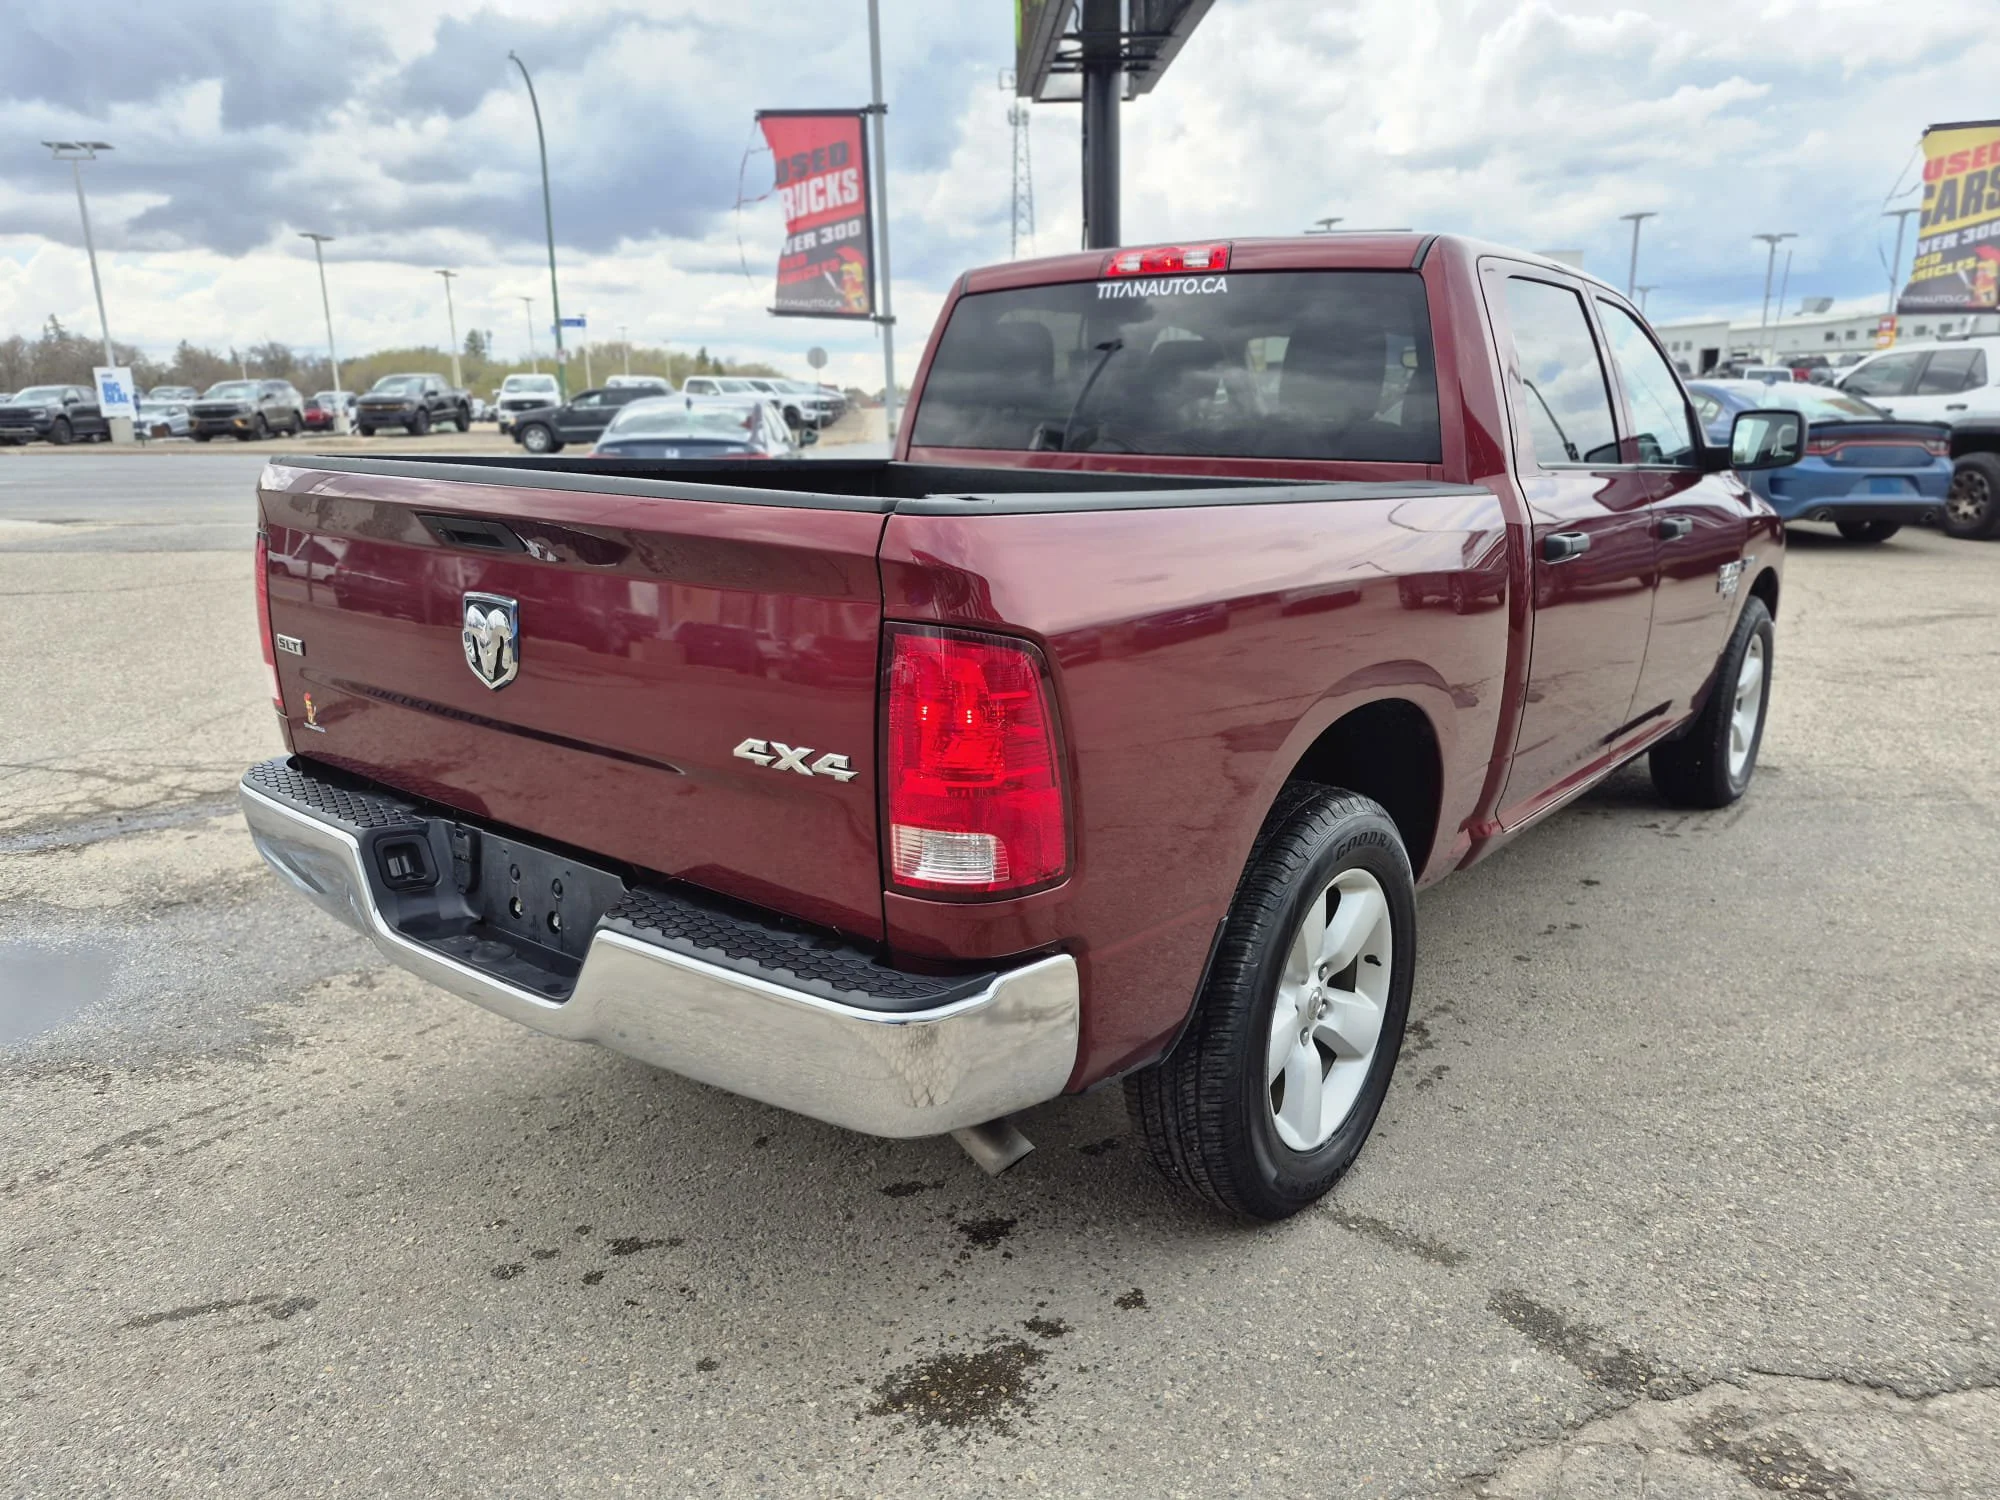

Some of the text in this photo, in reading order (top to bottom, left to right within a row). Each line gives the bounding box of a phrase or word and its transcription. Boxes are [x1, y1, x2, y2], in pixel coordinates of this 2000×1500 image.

[777, 168, 860, 222] RUCKS
[820, 219, 861, 244] 300
[1096, 277, 1228, 300] TITANAUTO.CA
[279, 637, 299, 653] SLT
